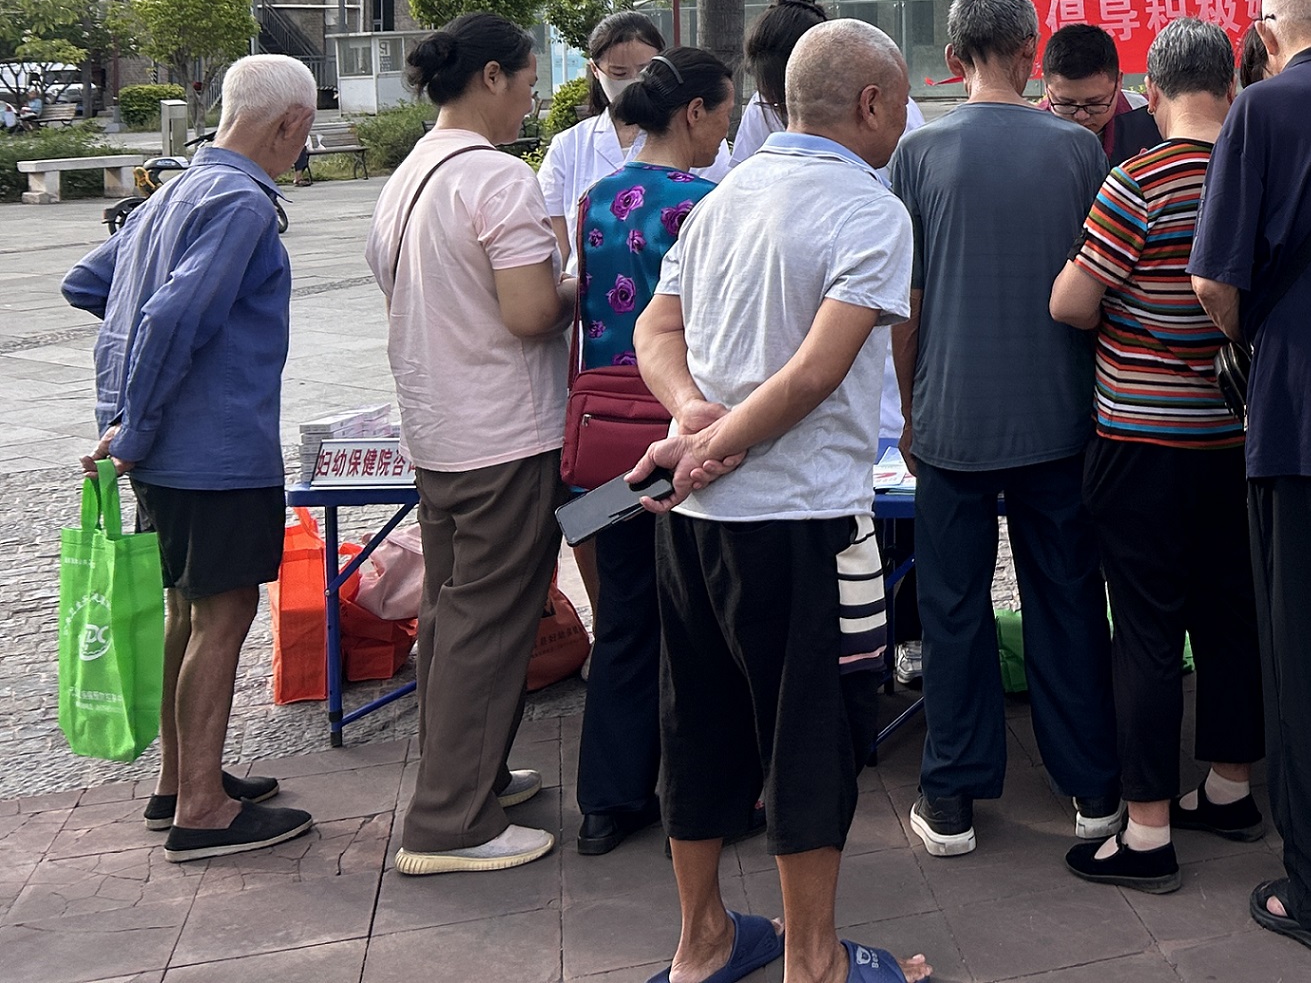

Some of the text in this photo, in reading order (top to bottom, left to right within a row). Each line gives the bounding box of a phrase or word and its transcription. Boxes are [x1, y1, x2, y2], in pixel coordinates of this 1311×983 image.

[315, 448, 416, 477] 妇幼保健院咨
